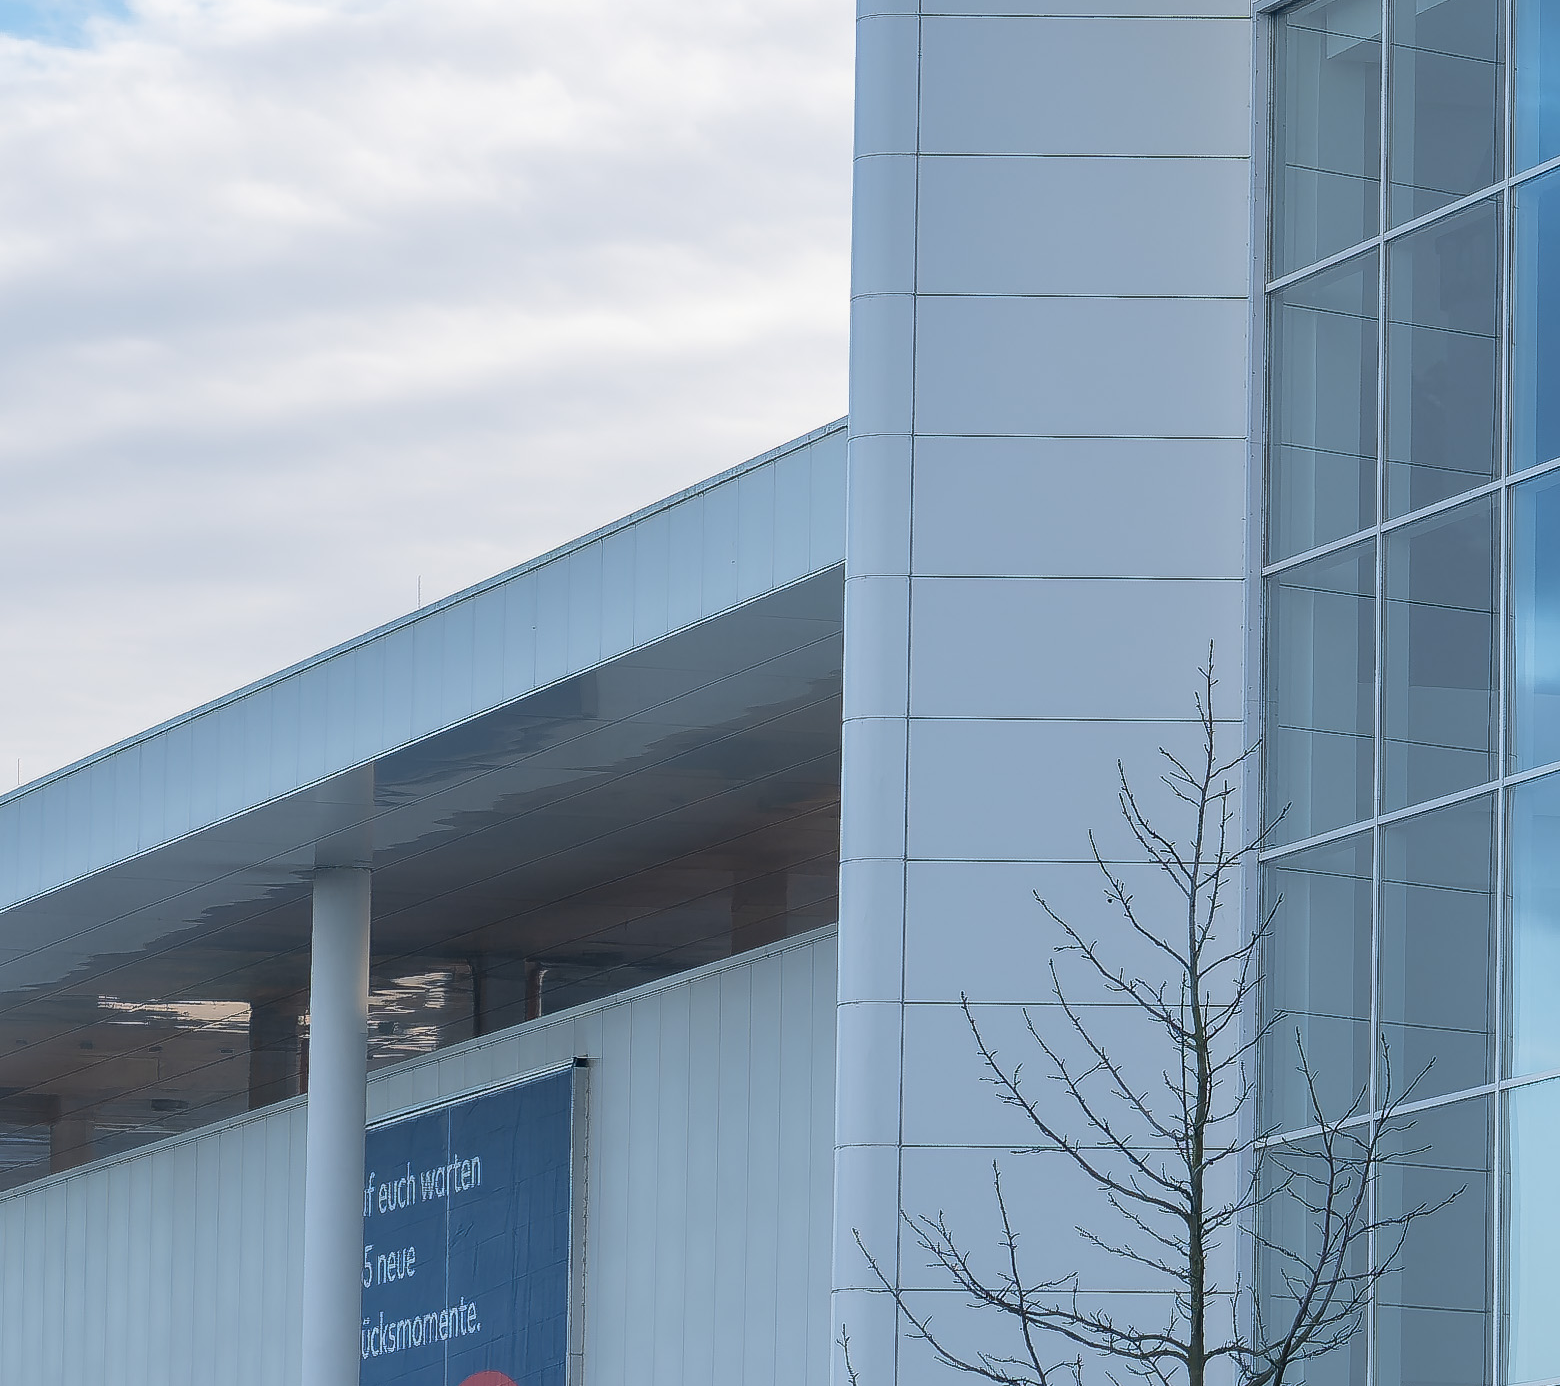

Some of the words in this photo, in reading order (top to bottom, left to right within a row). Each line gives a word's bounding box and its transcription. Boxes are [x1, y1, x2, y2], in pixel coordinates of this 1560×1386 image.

[378, 1162, 416, 1214] euch
[420, 1154, 482, 1203] warten
[377, 1245, 416, 1285] neue
